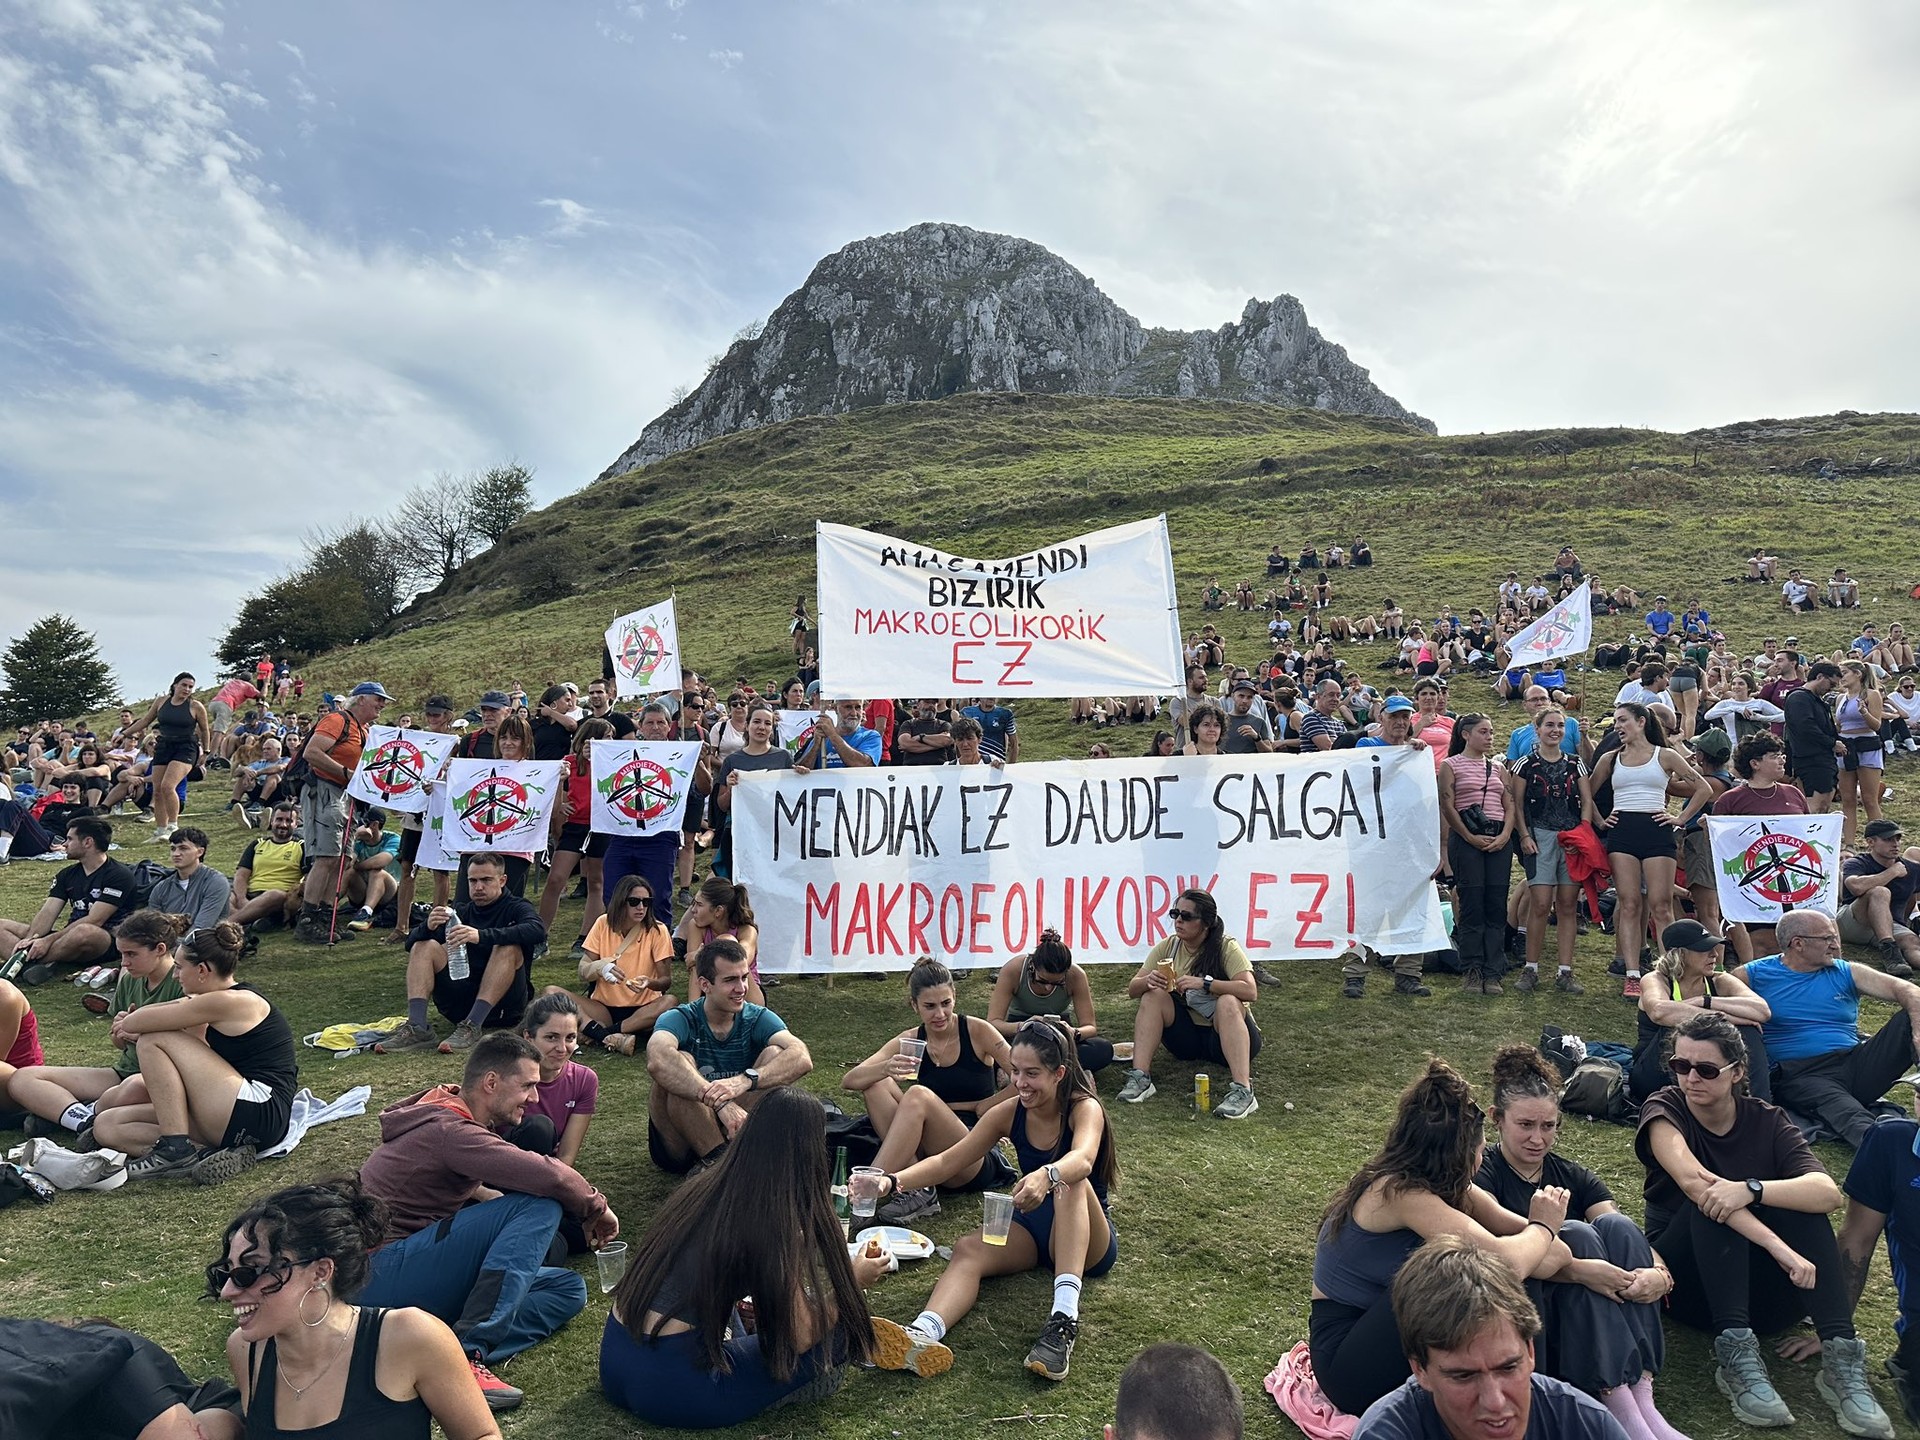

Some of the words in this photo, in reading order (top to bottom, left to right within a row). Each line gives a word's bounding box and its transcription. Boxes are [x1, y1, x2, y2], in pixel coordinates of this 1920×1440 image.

[928, 576, 1048, 609] BIZIRIK
[854, 608, 1107, 642] MAKROEOLIKORIK
[952, 641, 1034, 686] EZ
[381, 741, 418, 755] MENDIETAN
[620, 761, 663, 776] MENDIETAN
[475, 779, 519, 793] MENDIETAN
[773, 774, 943, 861] MENDIAK
[960, 783, 1013, 855] EZ
[1045, 775, 1184, 848] DAUDE
[1213, 755, 1386, 849] SALGAI
[1751, 835, 1803, 854] MENDIETAN
[1245, 872, 1357, 949] EZ!
[1781, 894, 1793, 902] EZ
